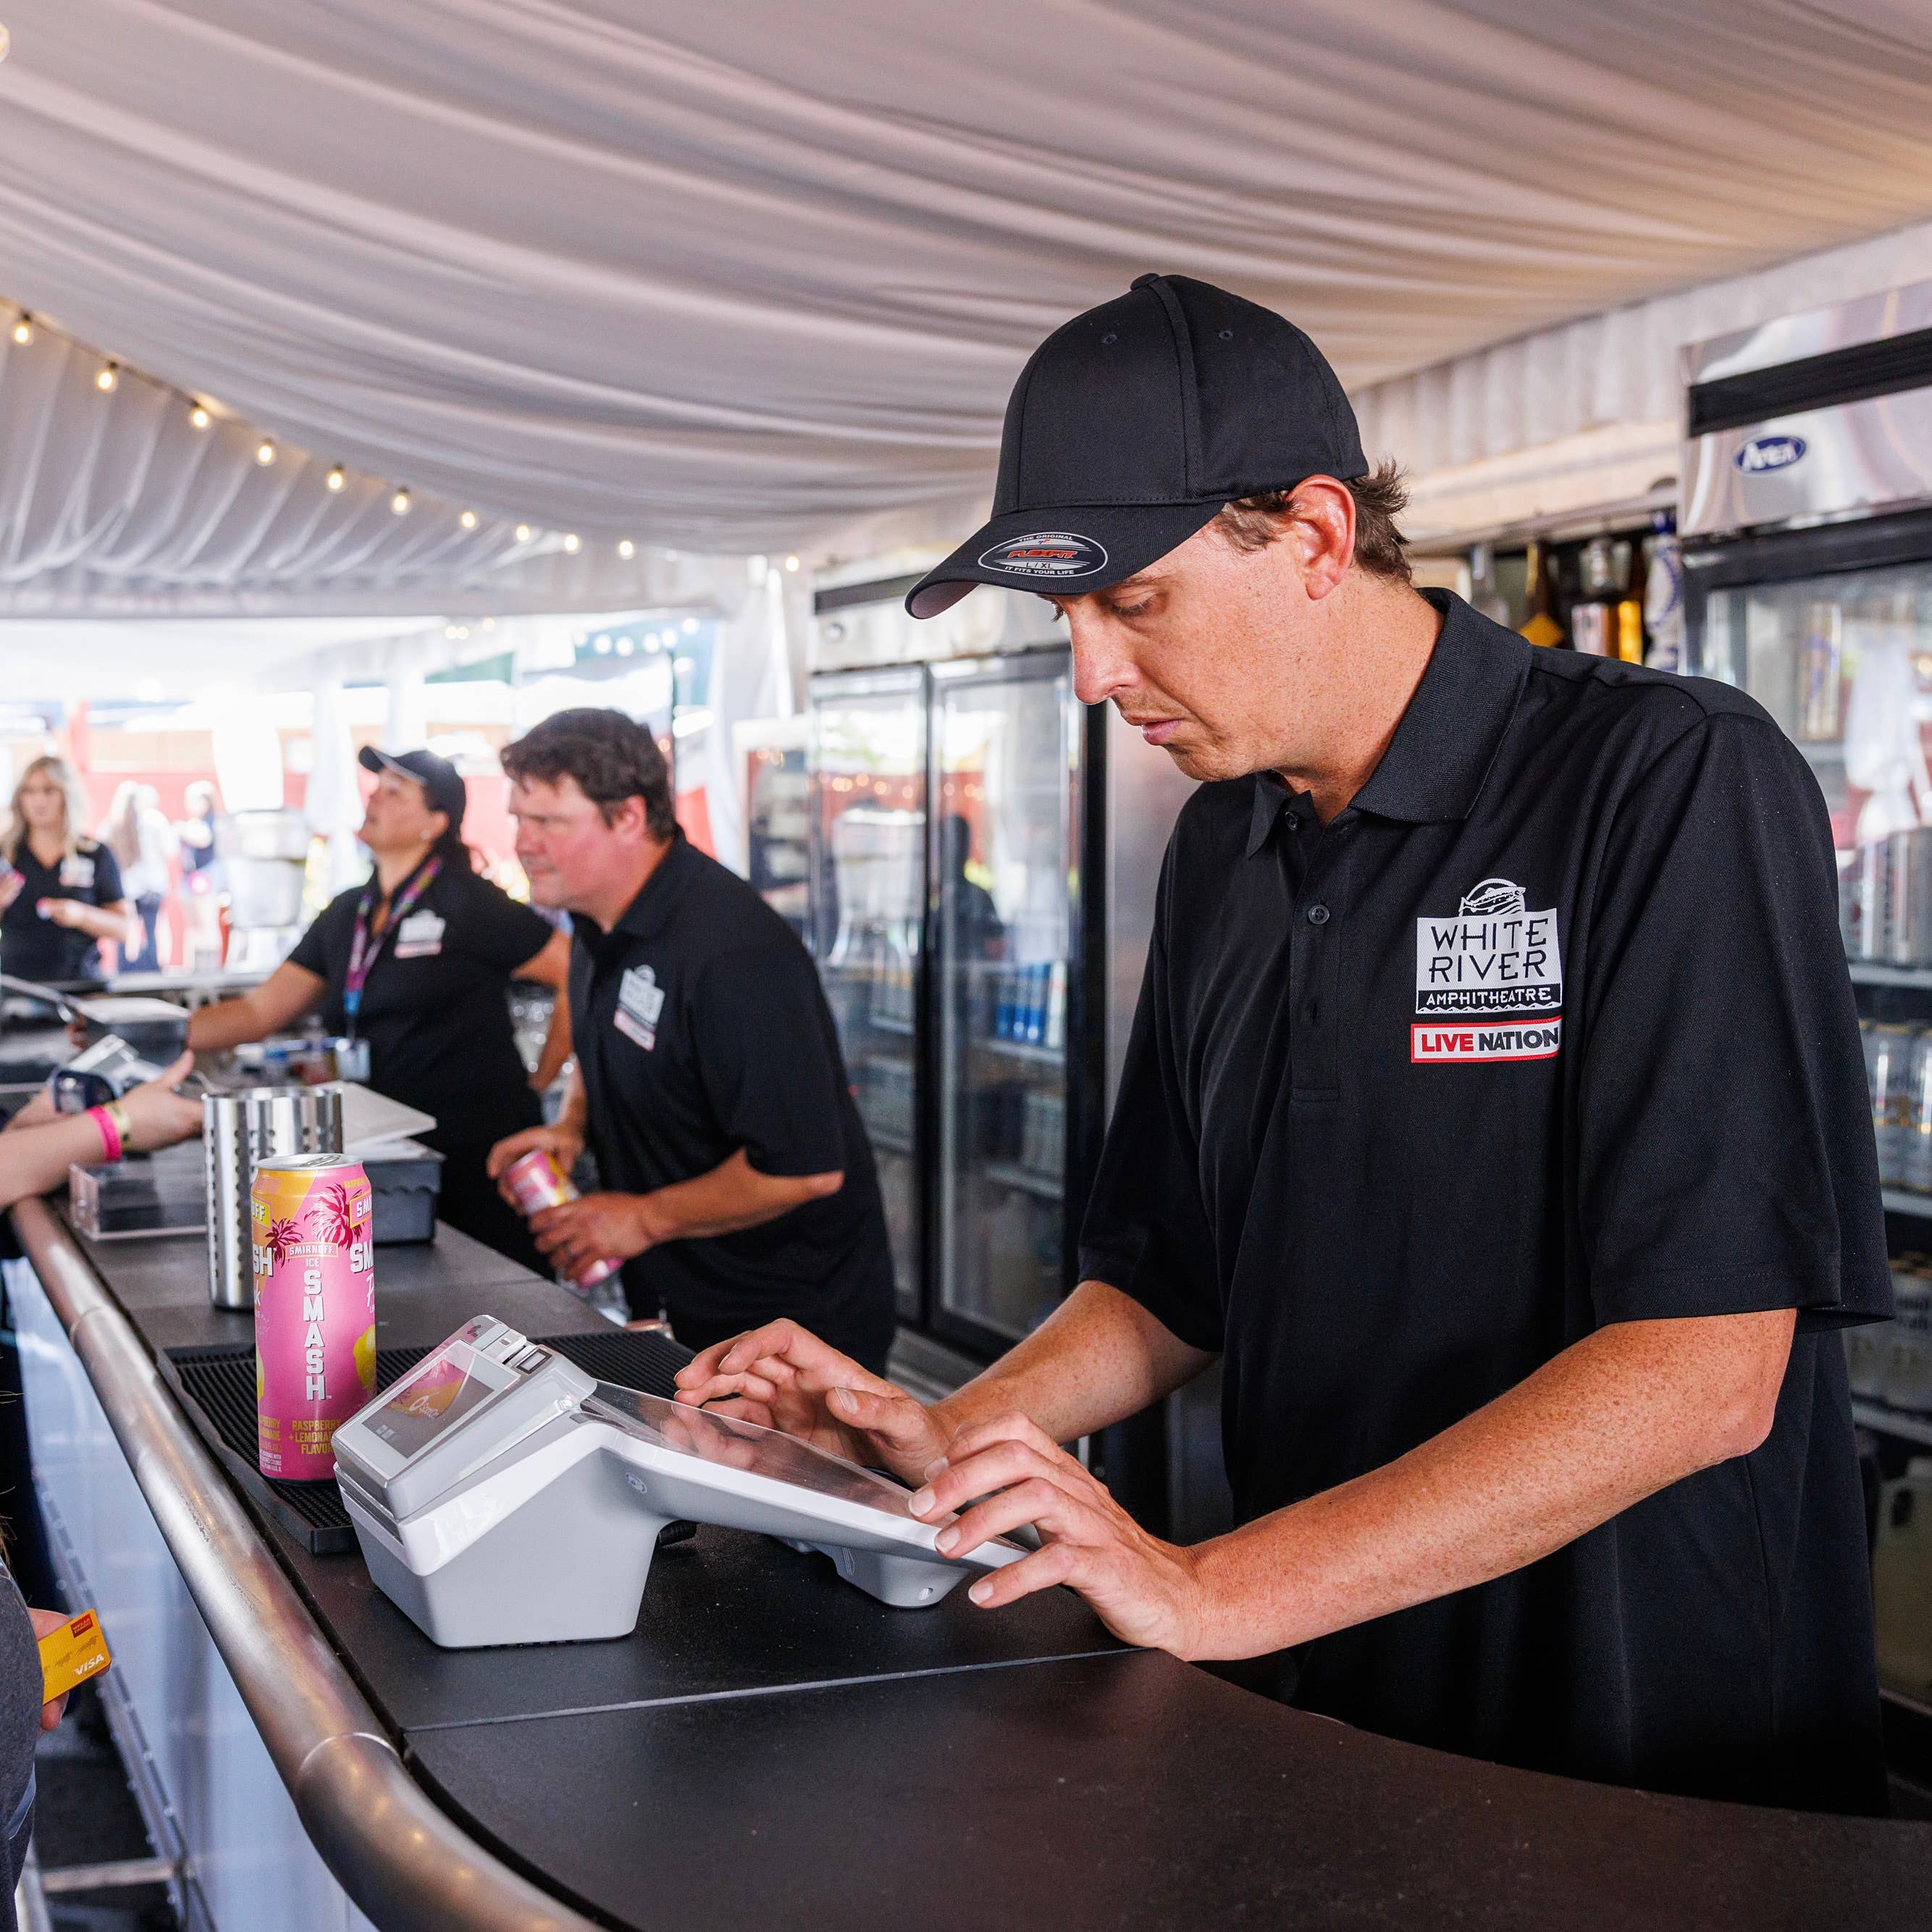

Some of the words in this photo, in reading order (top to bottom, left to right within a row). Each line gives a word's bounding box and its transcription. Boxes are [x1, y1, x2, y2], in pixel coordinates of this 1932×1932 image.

[1431, 918, 1548, 951] WHITE
[1429, 950, 1547, 983] RIVER
[1426, 987, 1551, 1006] AMPHITHEATRE
[1421, 1033, 1474, 1052] LIVE
[1479, 1027, 1558, 1051] NATION
[290, 1245, 333, 1256] SMIRNOFF
[306, 1259, 319, 1267] ICE
[303, 1269, 325, 1400] SMASH
[74, 1654, 104, 1675] VISA
